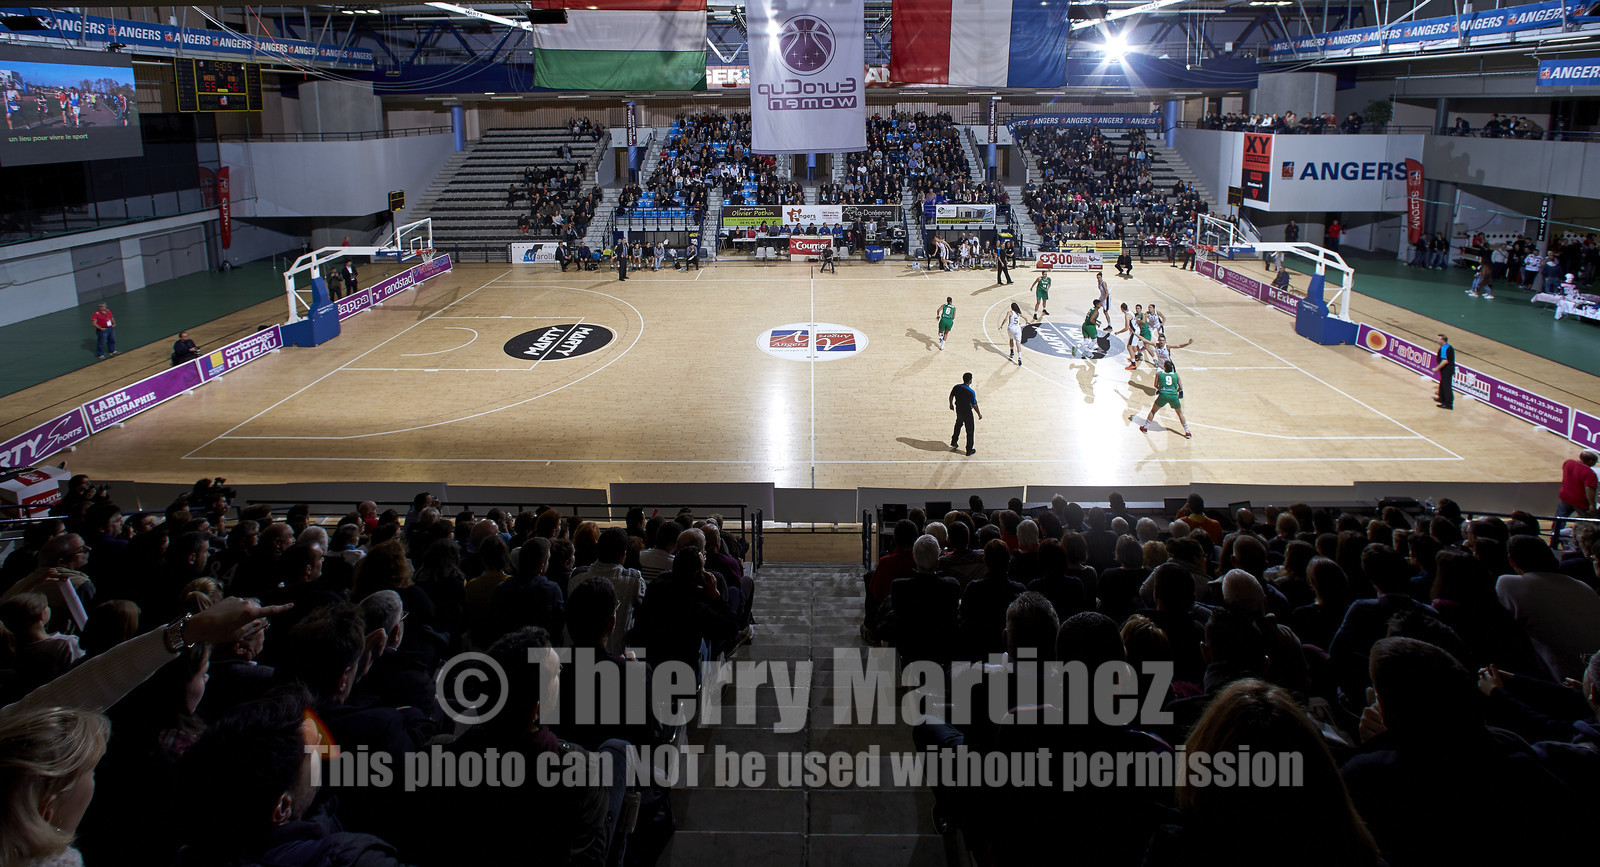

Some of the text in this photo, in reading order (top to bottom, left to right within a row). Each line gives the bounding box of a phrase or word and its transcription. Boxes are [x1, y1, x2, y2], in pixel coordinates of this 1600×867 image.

[1516, 6, 1572, 25] ANGERS
[53, 19, 105, 35] ANGERS
[1410, 22, 1449, 37] ANGERS
[1460, 16, 1504, 31] ANGERS
[118, 27, 161, 41] ANGERS
[174, 33, 211, 46] ANGERS
[1332, 32, 1362, 46] ANGERS
[1367, 29, 1402, 43] ANGERS
[220, 35, 252, 49] ANGERS
[260, 42, 288, 54] ANGERS
[1300, 37, 1326, 48] ANGERS
[293, 46, 319, 56] ANGERS
[352, 50, 373, 61] ANGERS
[1550, 65, 1600, 80] ANGER
[1033, 117, 1059, 126] ANGERS
[1066, 117, 1092, 126] ANGERS
[1097, 117, 1124, 126] ANGERS
[1130, 117, 1156, 126] ANGERS
[72, 133, 89, 141] sport
[1246, 136, 1270, 154] XY
[1299, 162, 1407, 180] ANGERS
[1538, 200, 1548, 241] BUVETTE
[796, 240, 828, 251] Courrier
[384, 271, 413, 295] randstad
[1269, 288, 1276, 298] In
[945, 307, 952, 315] 6
[1013, 317, 1019, 325] 5
[225, 330, 275, 357] cartonnages
[523, 326, 565, 356] MARTY
[556, 327, 594, 357] MARTY
[818, 333, 852, 341] Angers
[771, 341, 808, 349] Angers
[227, 338, 277, 368] HUTEAU
[1389, 338, 1432, 369] l'atoll
[1165, 376, 1173, 386] 9
[1497, 385, 1519, 398] ANGERS
[89, 391, 131, 415] LABEL
[94, 392, 157, 425] SÉRIGRAPHIE
